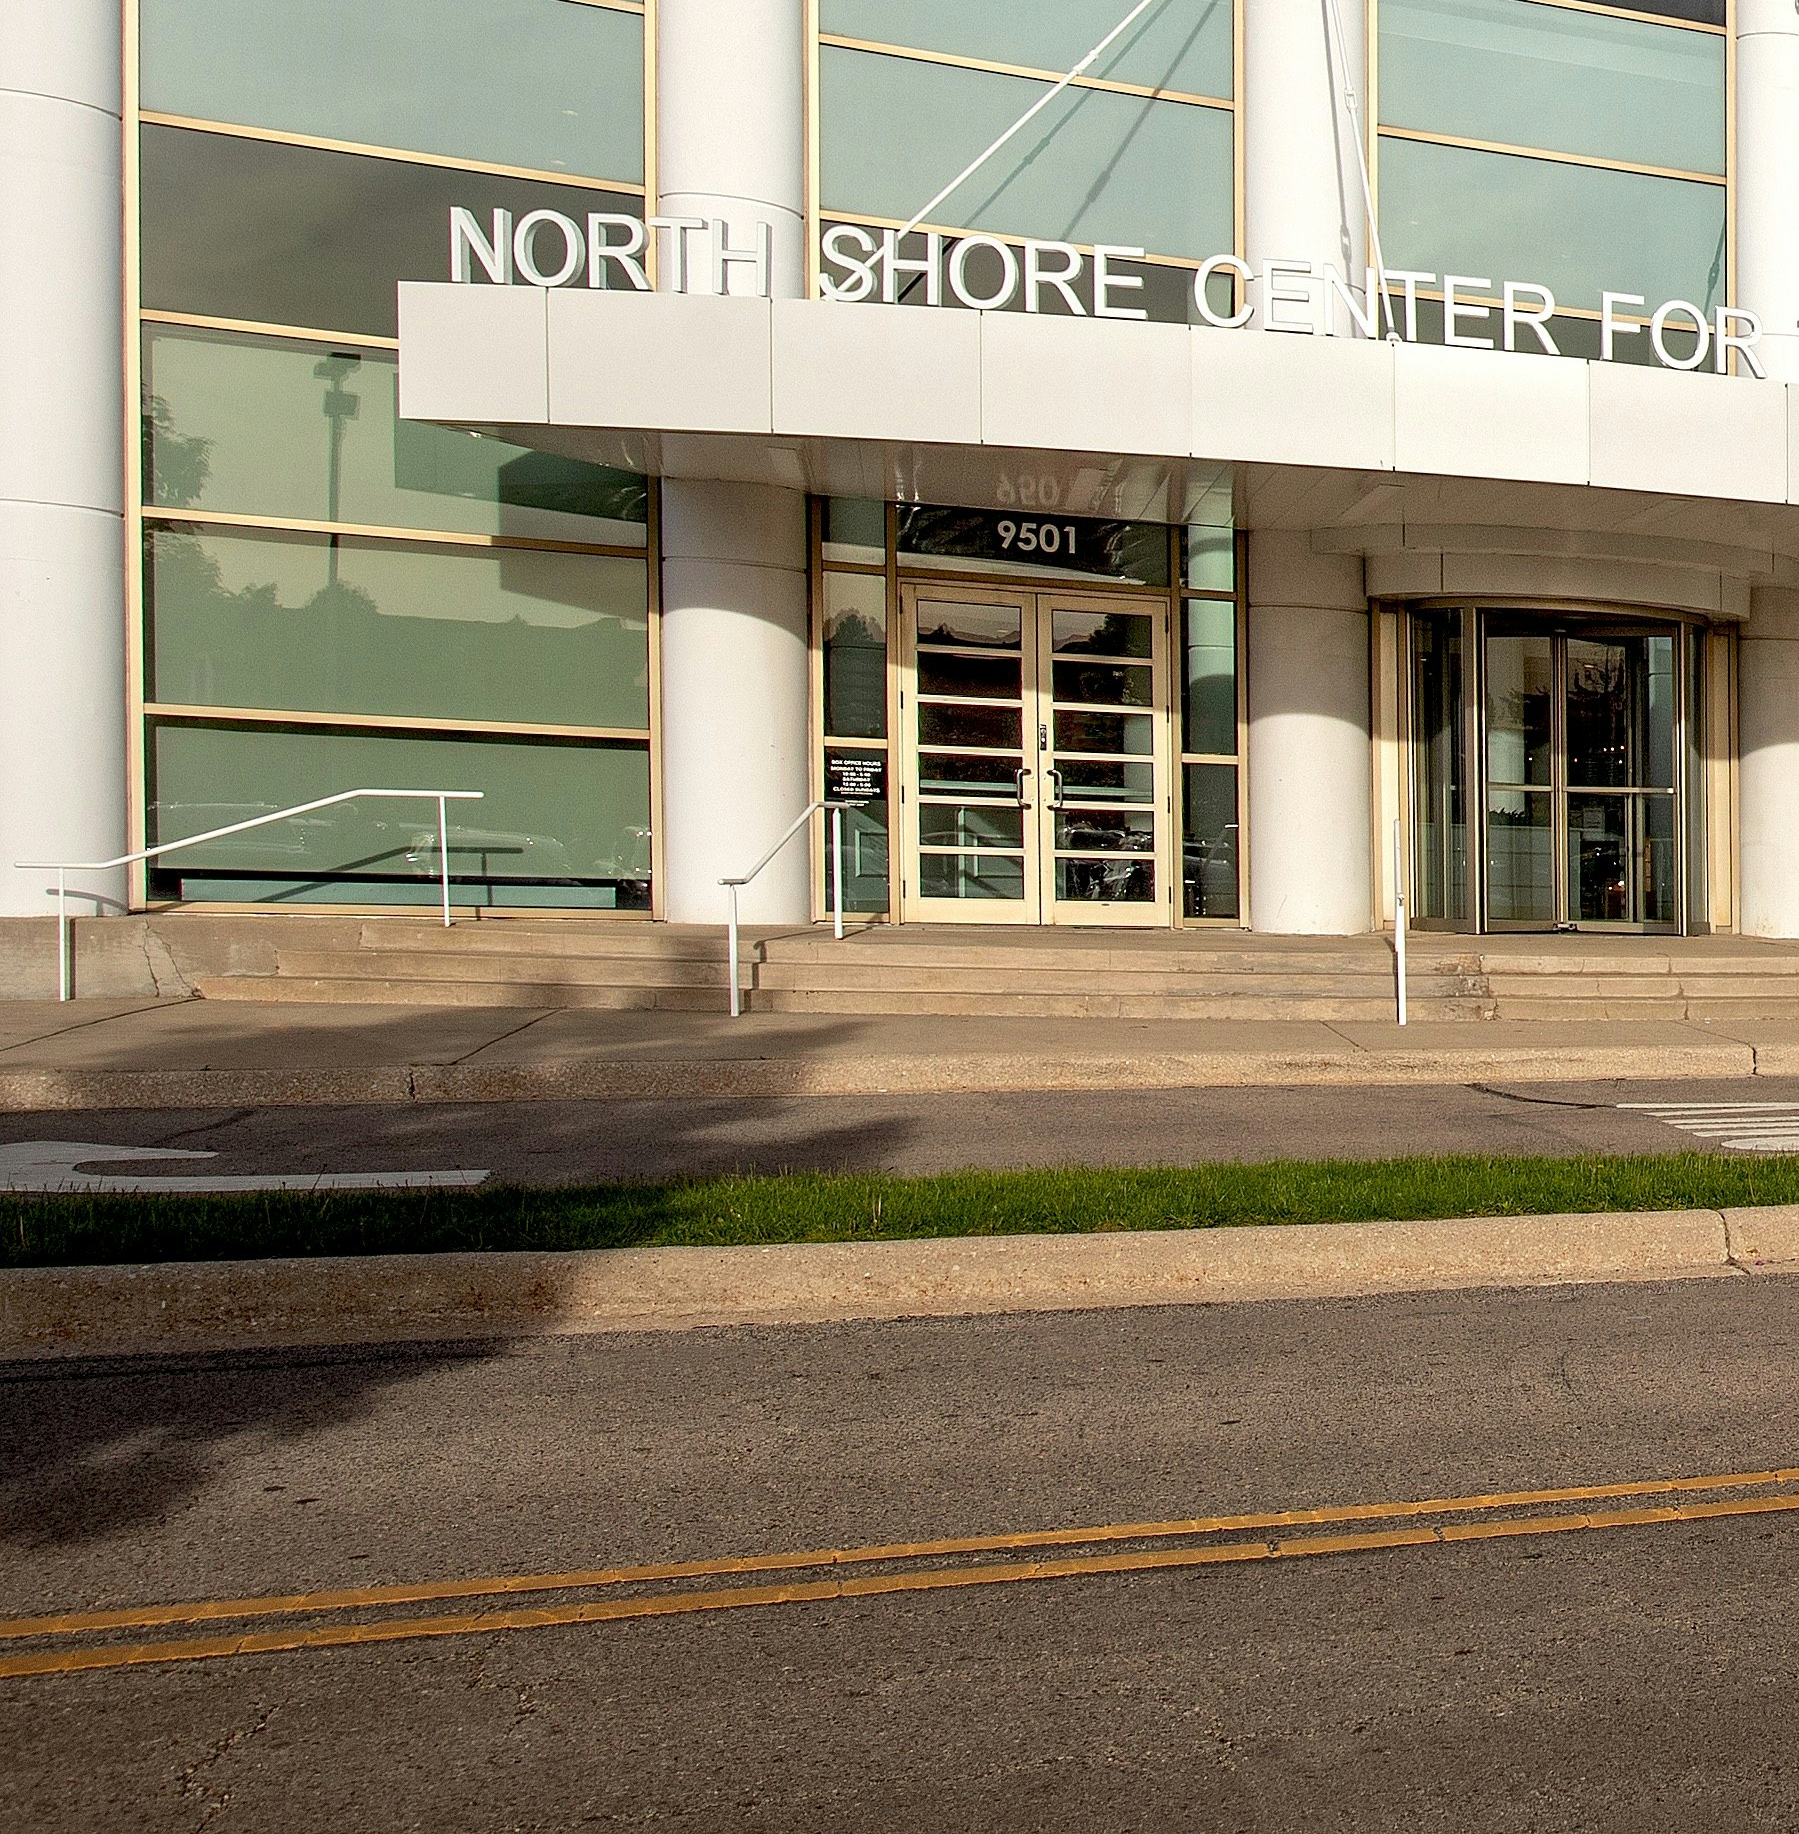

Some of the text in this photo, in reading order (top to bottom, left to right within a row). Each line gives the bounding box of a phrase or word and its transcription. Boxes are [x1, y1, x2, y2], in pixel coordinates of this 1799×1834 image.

[449, 206, 772, 297] NORTH
[819, 225, 1148, 319] SHORE
[1194, 254, 1561, 356] CENTER
[1601, 291, 1767, 379] FOR
[997, 520, 1076, 554] 9501
